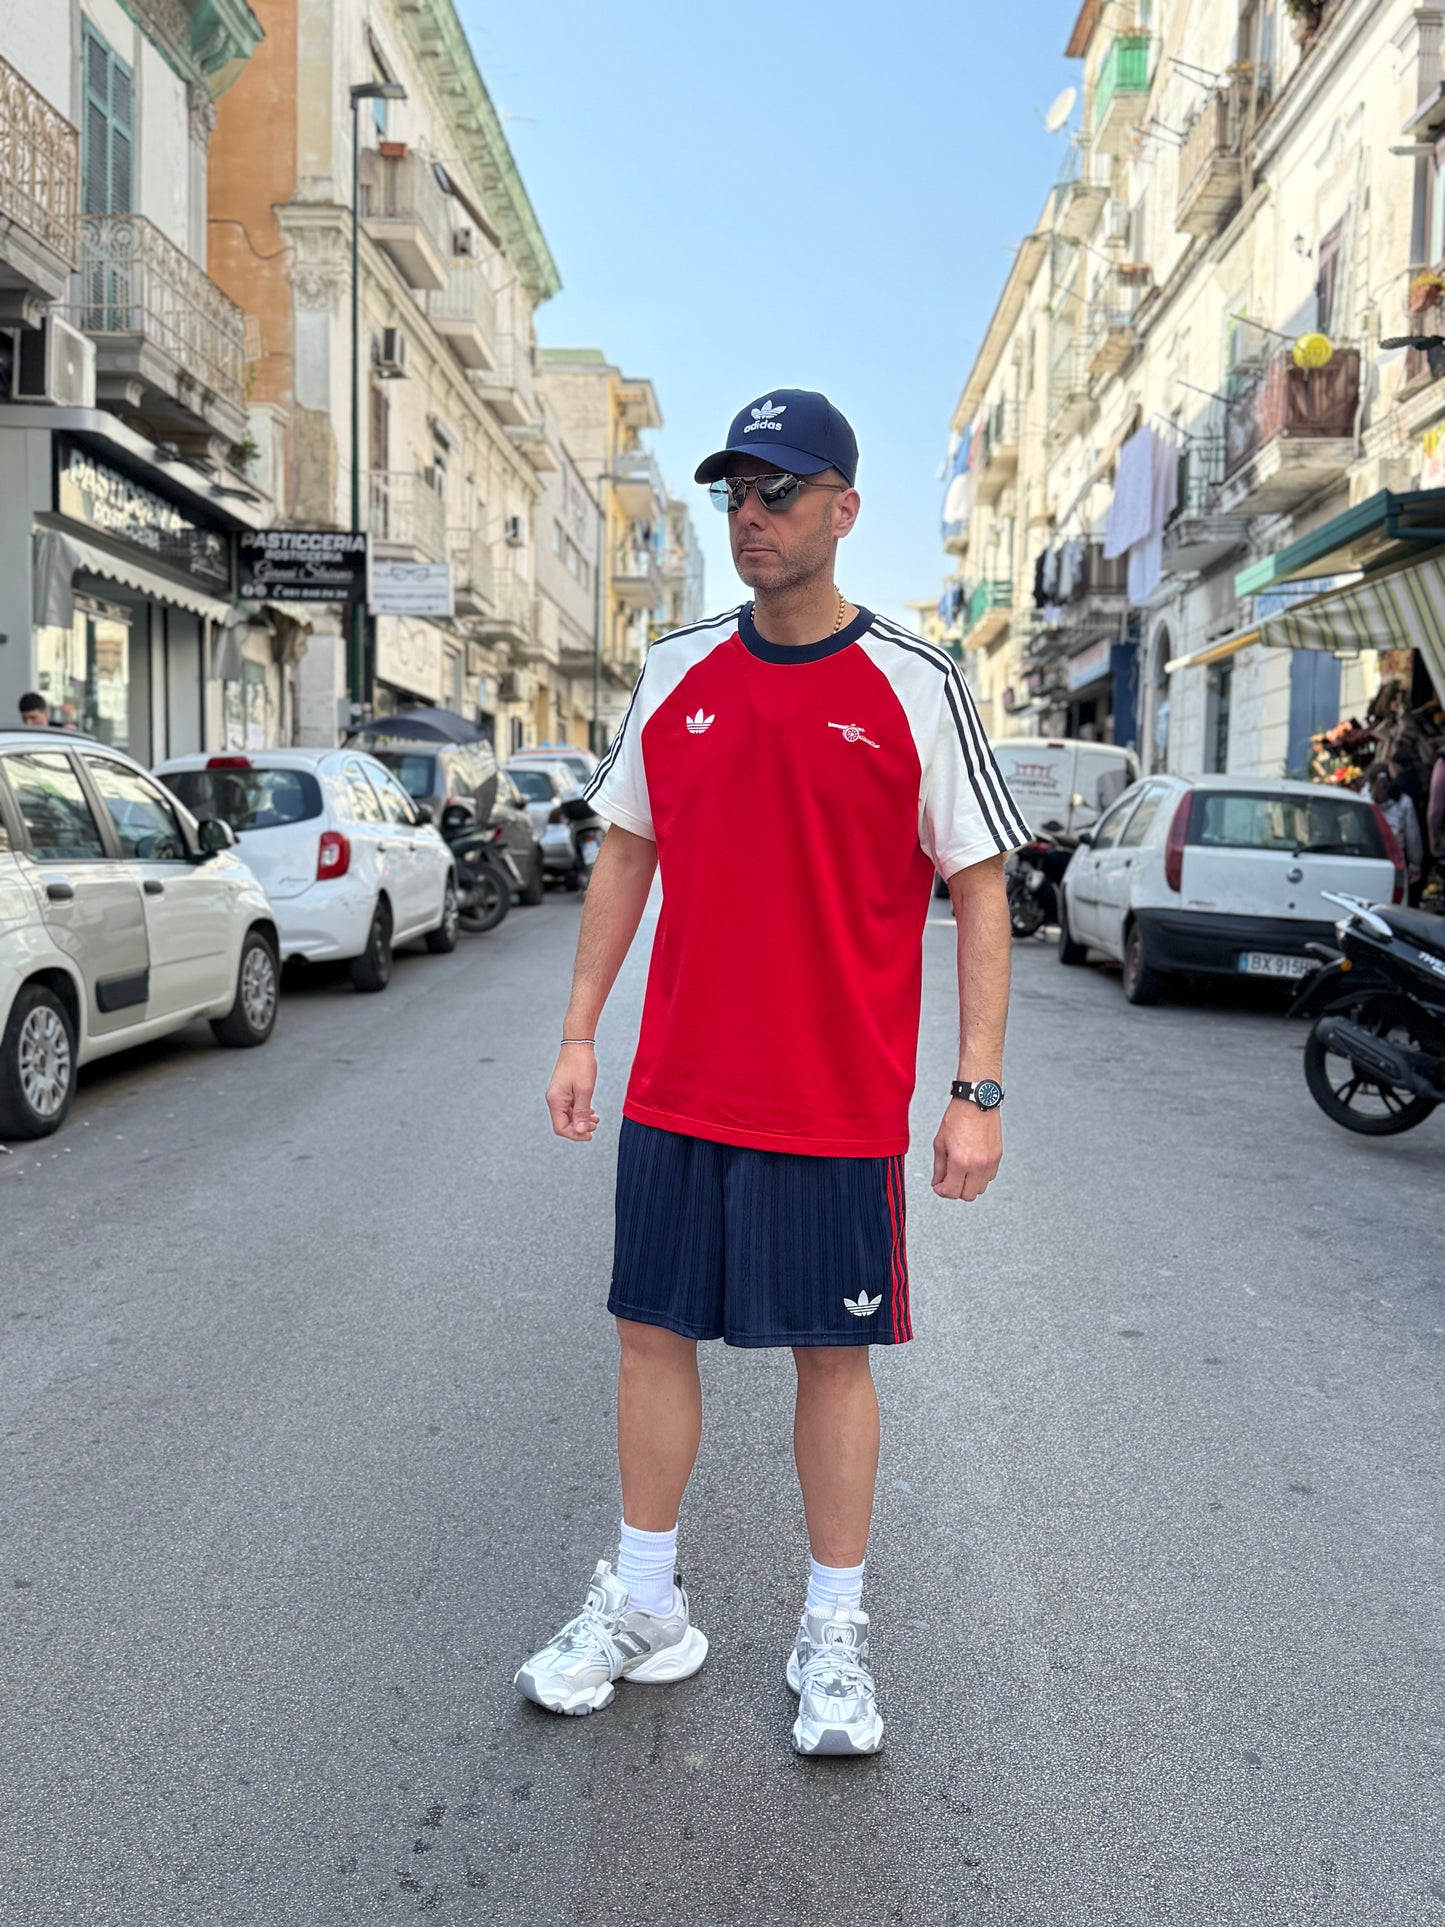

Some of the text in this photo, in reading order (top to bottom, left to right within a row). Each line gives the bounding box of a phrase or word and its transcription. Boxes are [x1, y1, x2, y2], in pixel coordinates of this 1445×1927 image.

[743, 419, 782, 433] adidas
[240, 531, 366, 553] PASTICCERIA
[264, 549, 344, 563] ROSTICCERIA
[1251, 955, 1271, 971] BX
